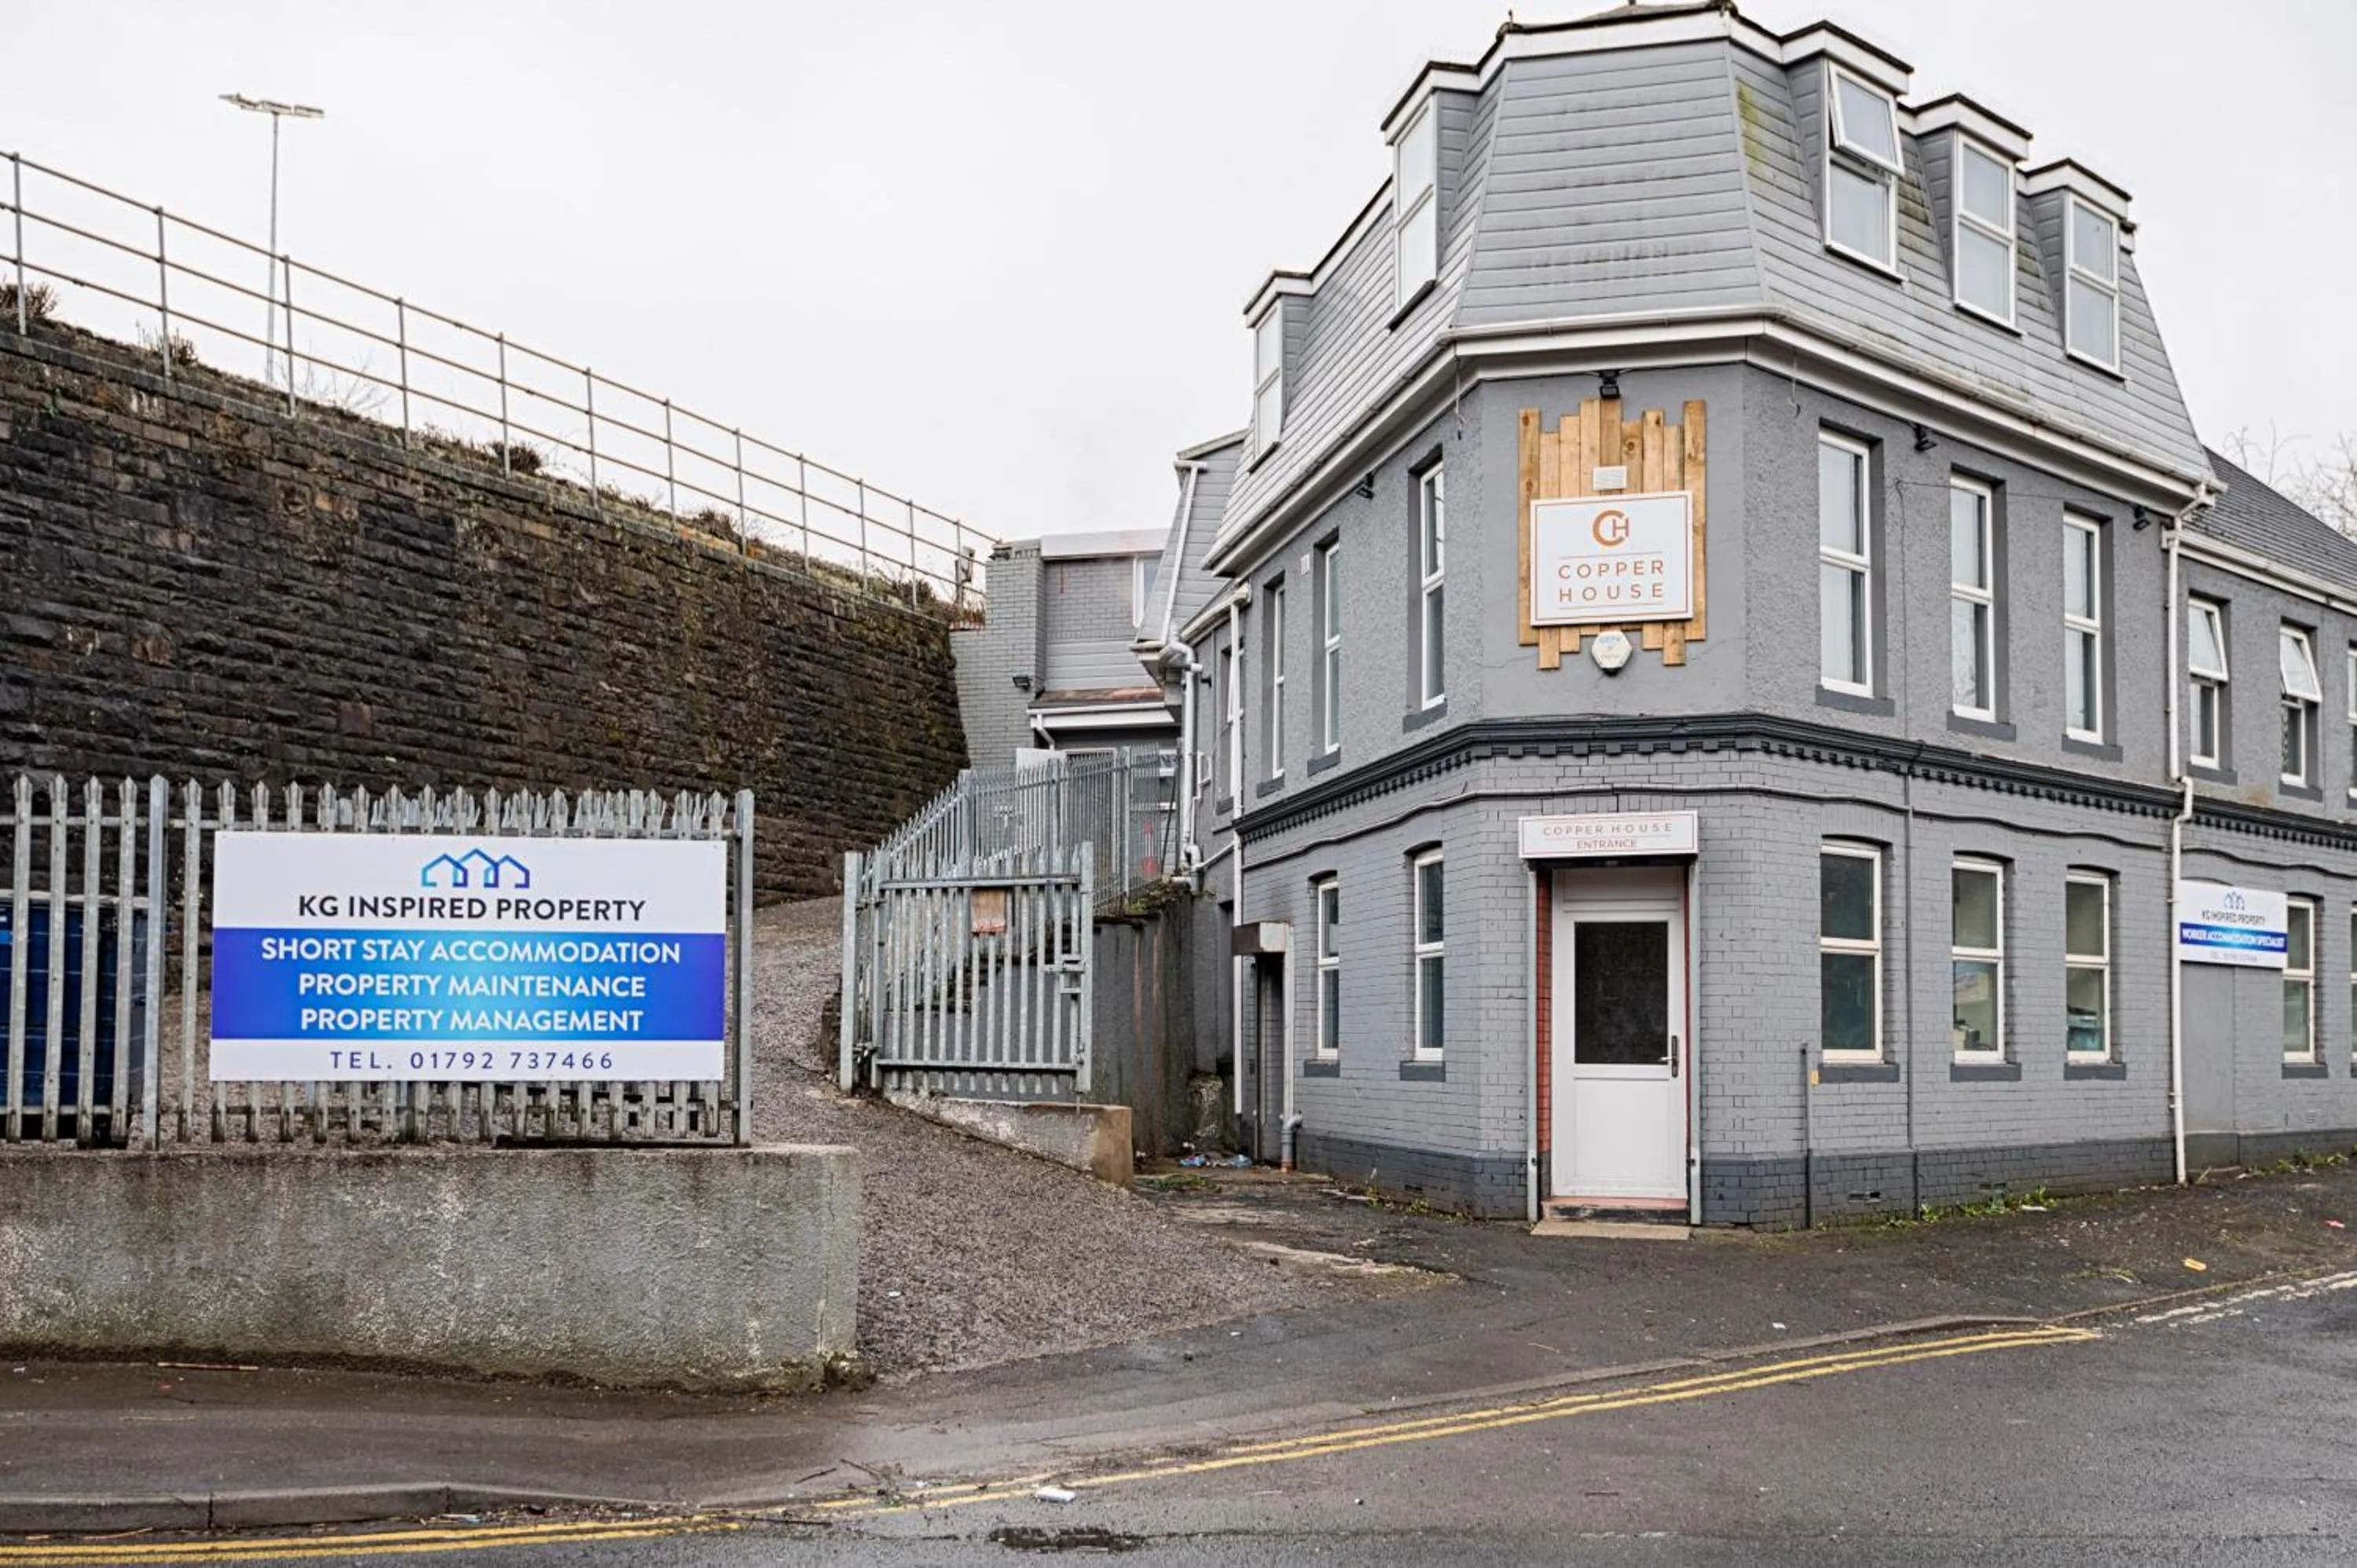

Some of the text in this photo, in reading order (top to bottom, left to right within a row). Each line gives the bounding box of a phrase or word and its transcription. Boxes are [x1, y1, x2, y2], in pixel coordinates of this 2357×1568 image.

[1558, 559, 1664, 580] COPPER
[1559, 582, 1663, 603] HOUSE
[1543, 822, 1673, 836] COPPER HOUSE
[1577, 838, 1637, 849] ENTRANCE
[299, 896, 646, 921] KG INSPIRED PROPERTY
[262, 938, 680, 963] SHORT STAY ACCOMMODATION
[299, 973, 646, 997] PROPERTY MAINTENANCE
[301, 1009, 644, 1031] PROPERTY MANAGEMENT
[330, 1051, 613, 1069] TEL. 01792 737466
